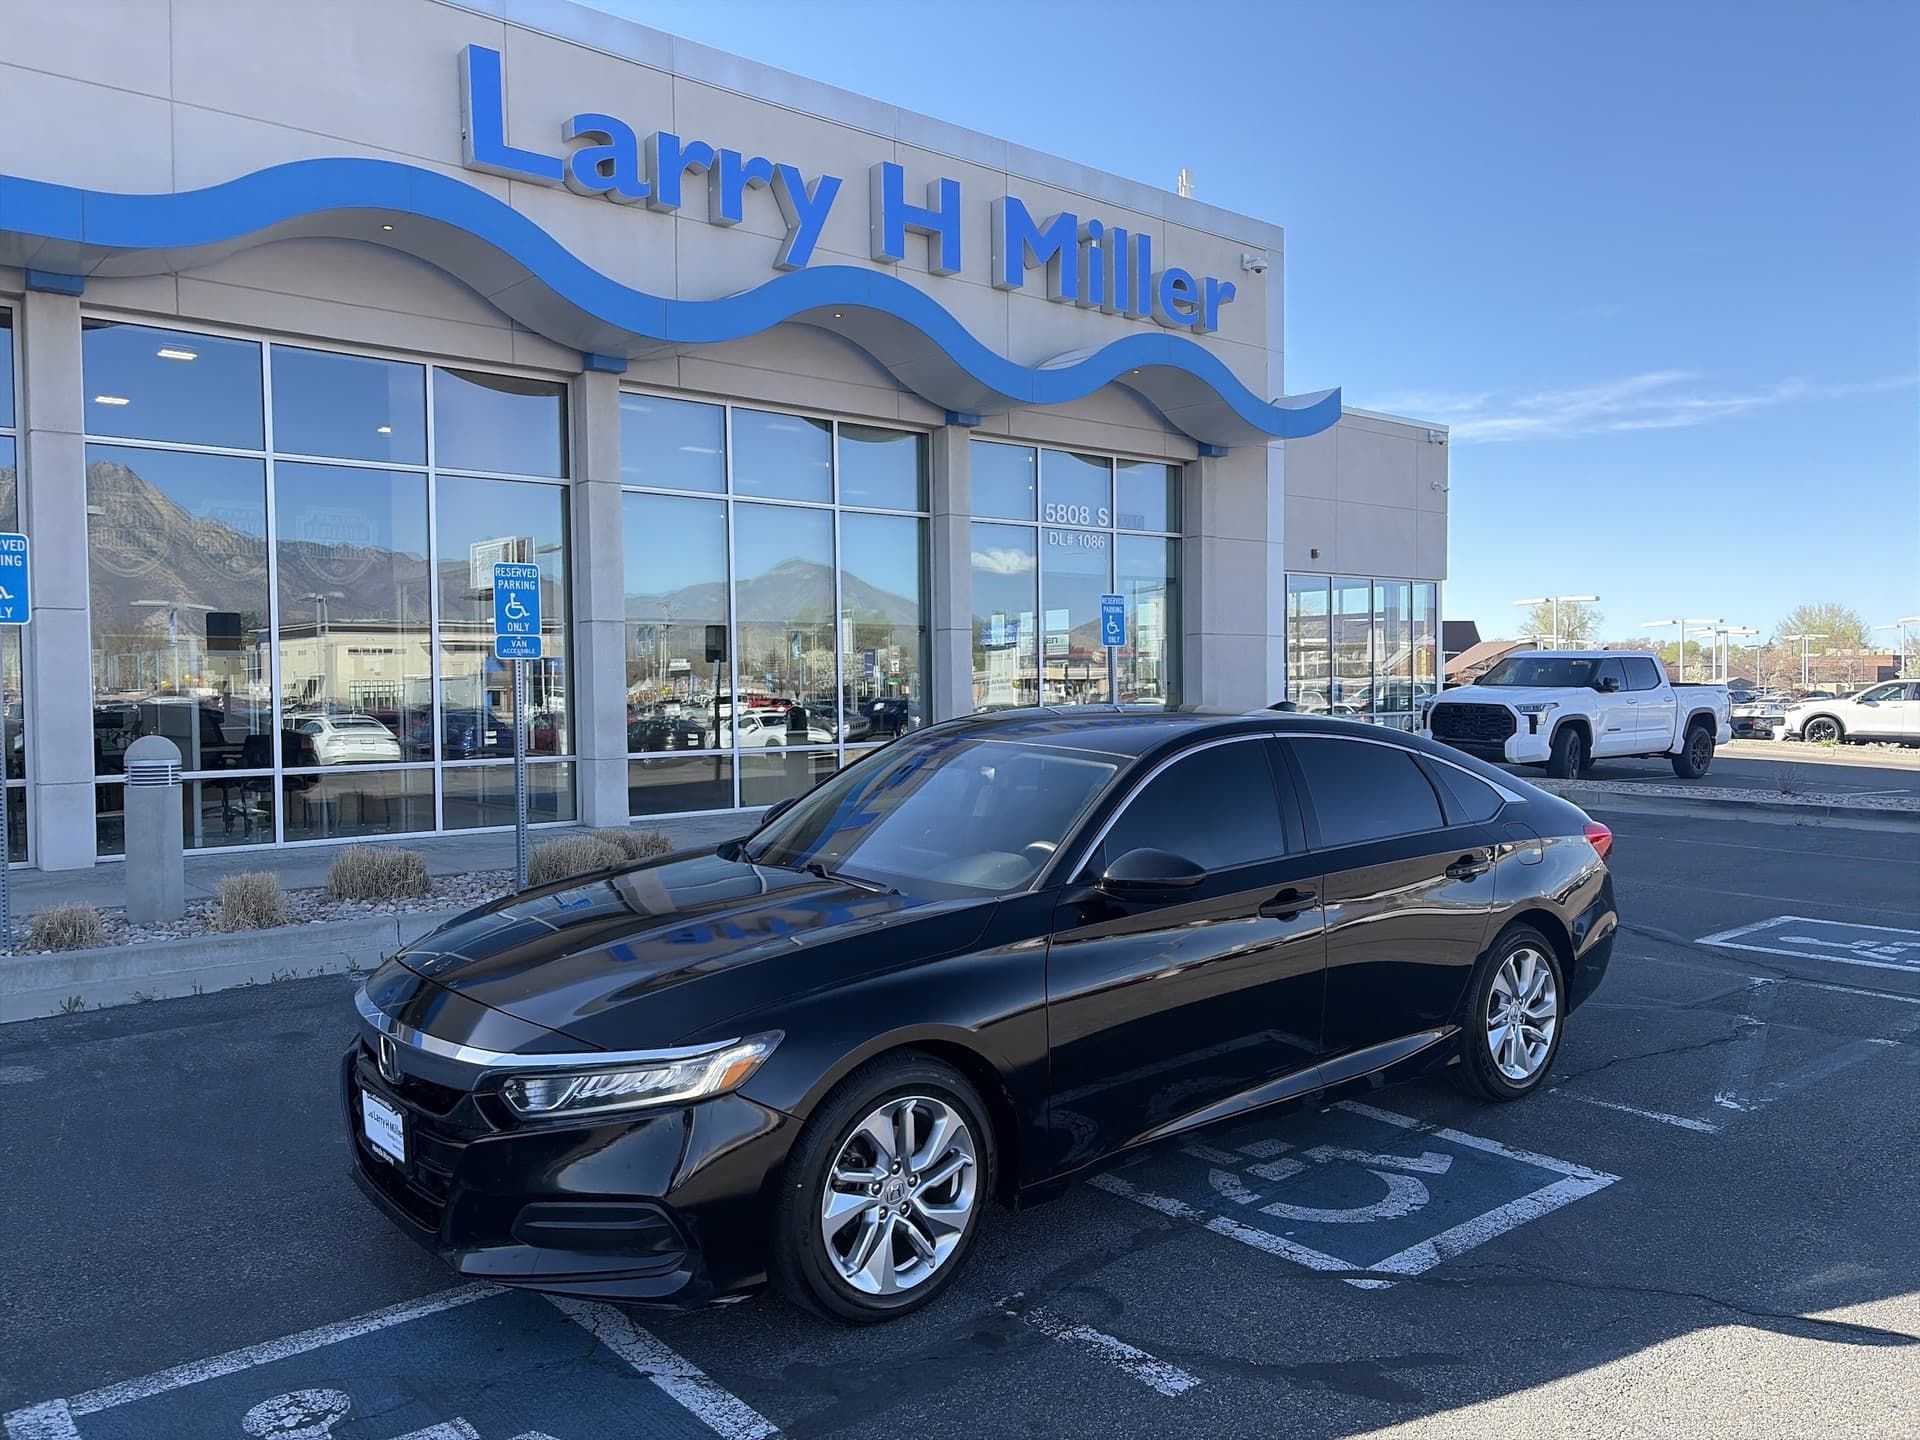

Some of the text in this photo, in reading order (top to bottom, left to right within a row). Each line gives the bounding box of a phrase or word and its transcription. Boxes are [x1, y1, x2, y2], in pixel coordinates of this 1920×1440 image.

[460, 44, 1237, 333] Larry H Miller
[1045, 503, 1109, 526] 5808 S
[0, 540, 25, 551] VED
[1049, 531, 1105, 549] DL# 1086
[495, 567, 537, 578] RESERVED
[498, 579, 536, 590] PARKING
[507, 622, 530, 632] ONLY
[511, 640, 527, 648] VAN
